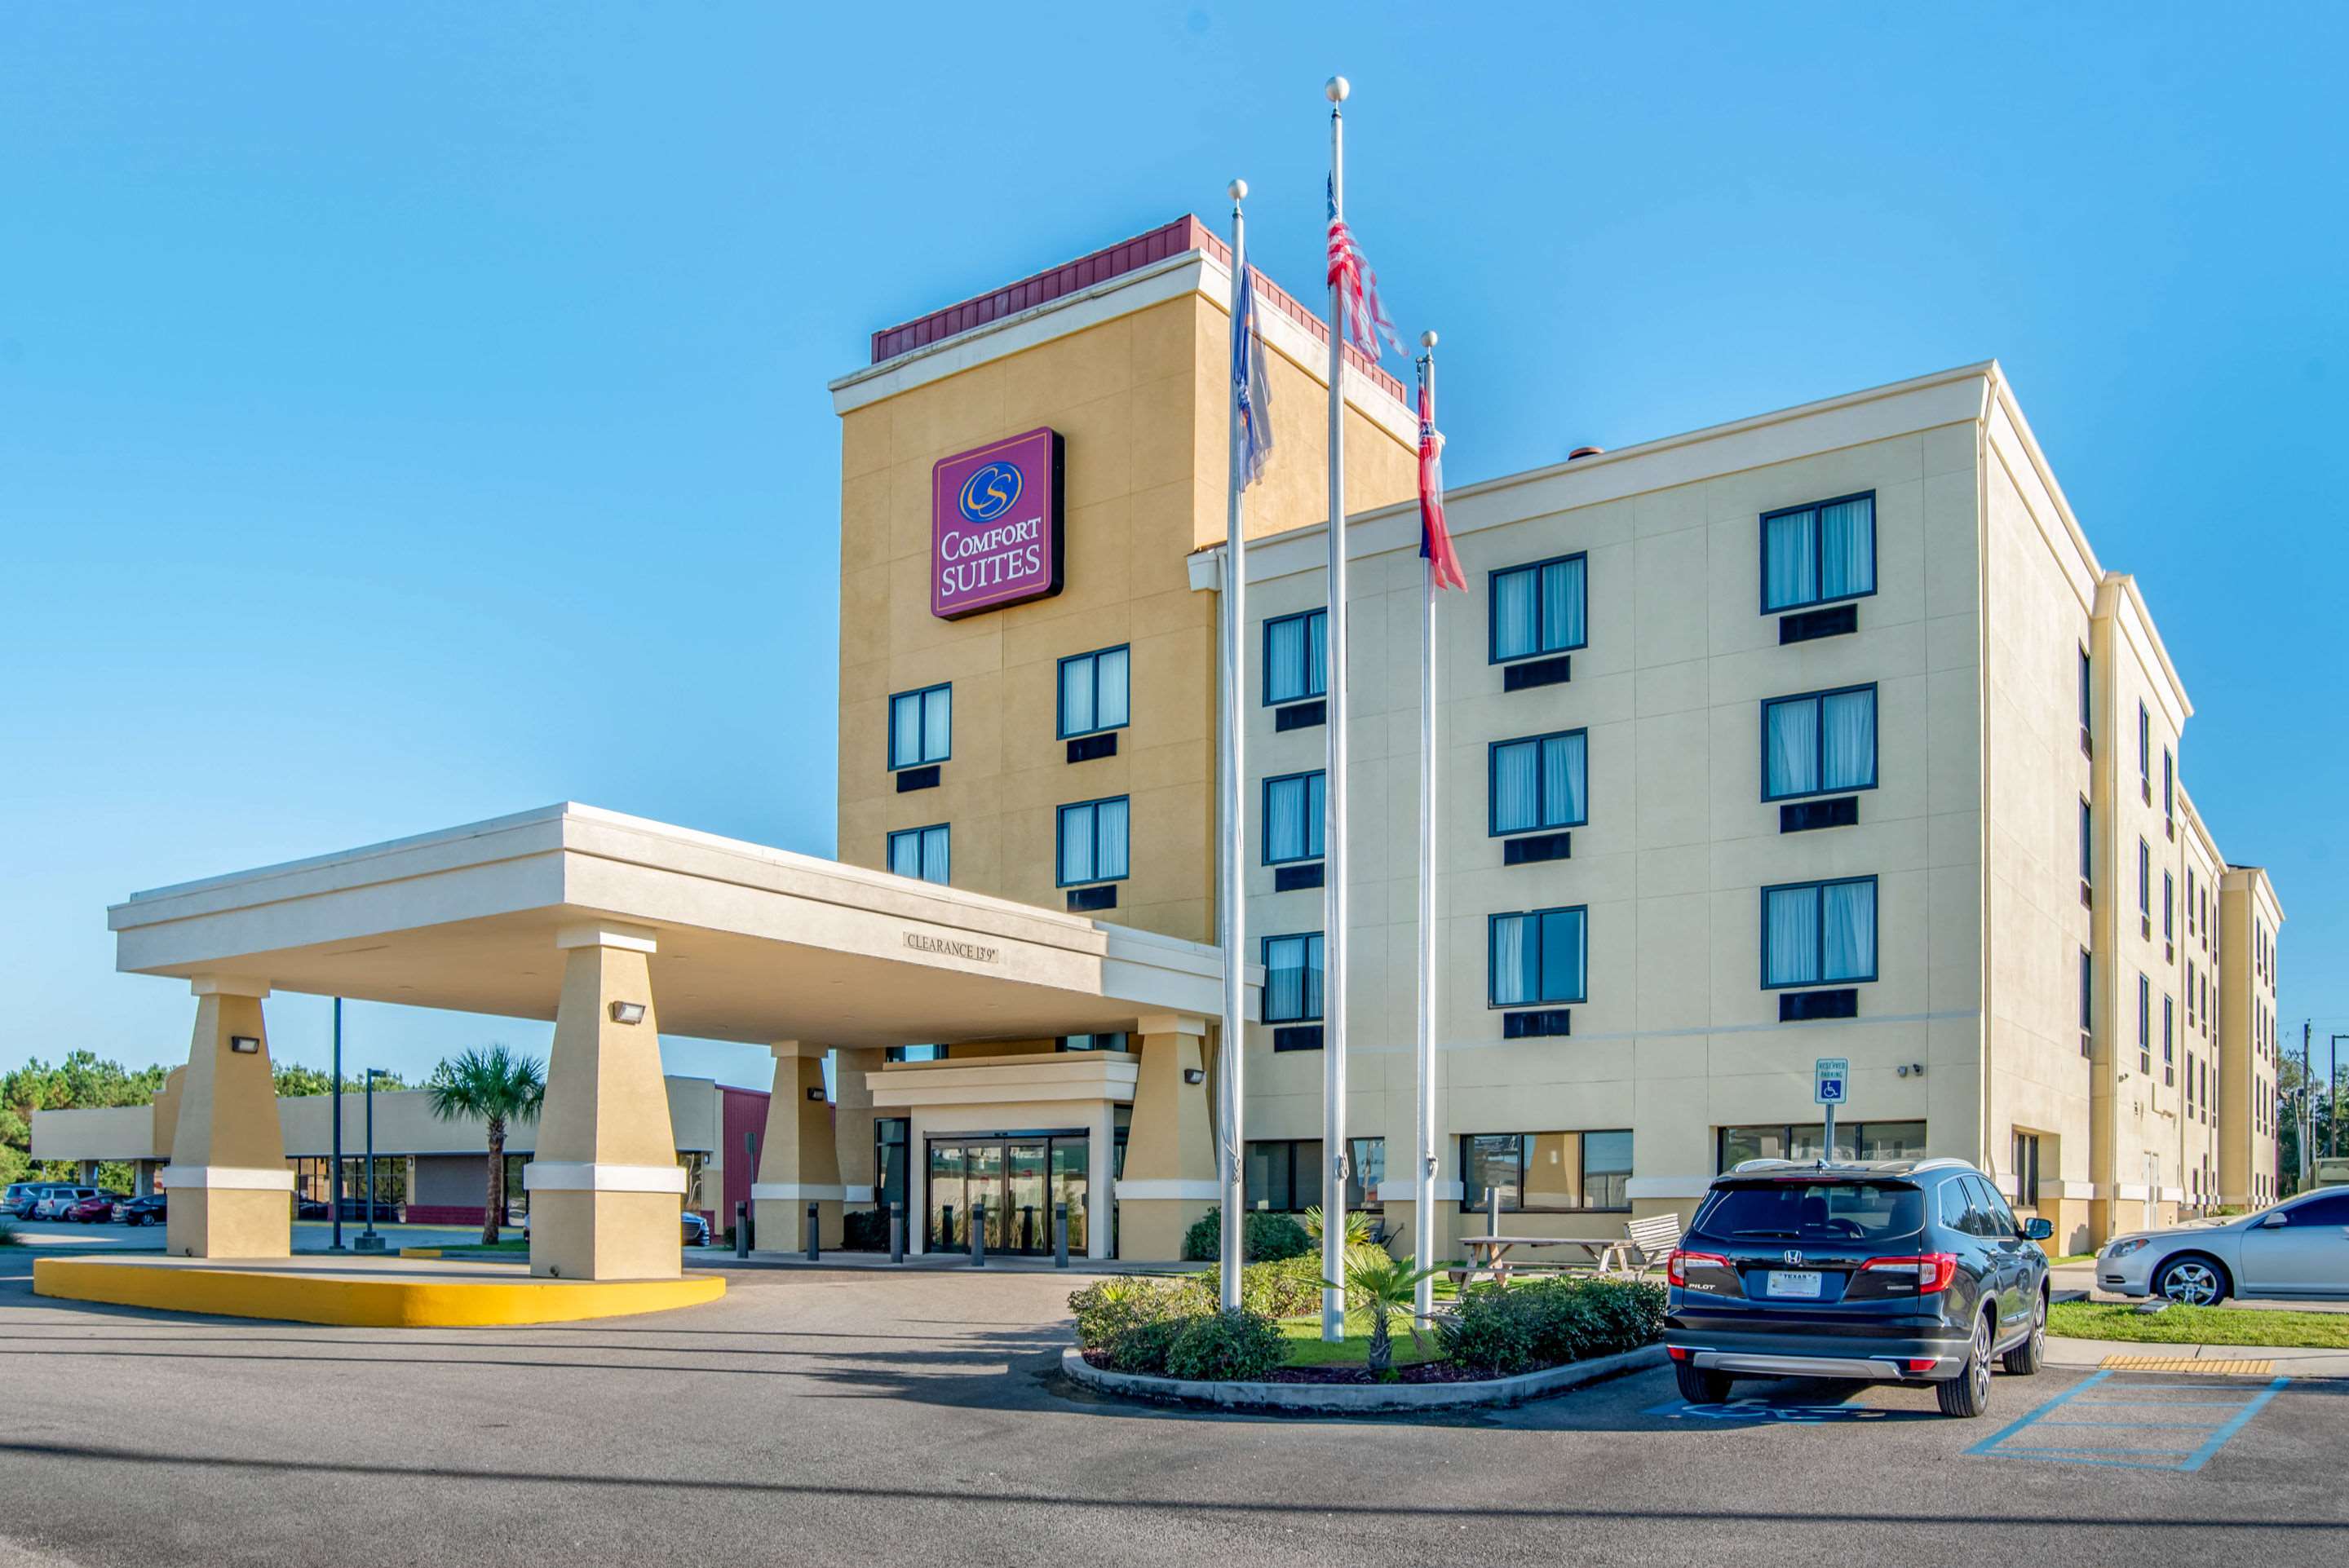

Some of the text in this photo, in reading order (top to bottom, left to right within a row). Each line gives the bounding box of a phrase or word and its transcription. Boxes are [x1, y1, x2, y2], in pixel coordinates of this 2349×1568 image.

[941, 517, 1041, 561] COMFORT
[941, 544, 1040, 596] SUITES
[907, 933, 973, 958] CLEARANCE
